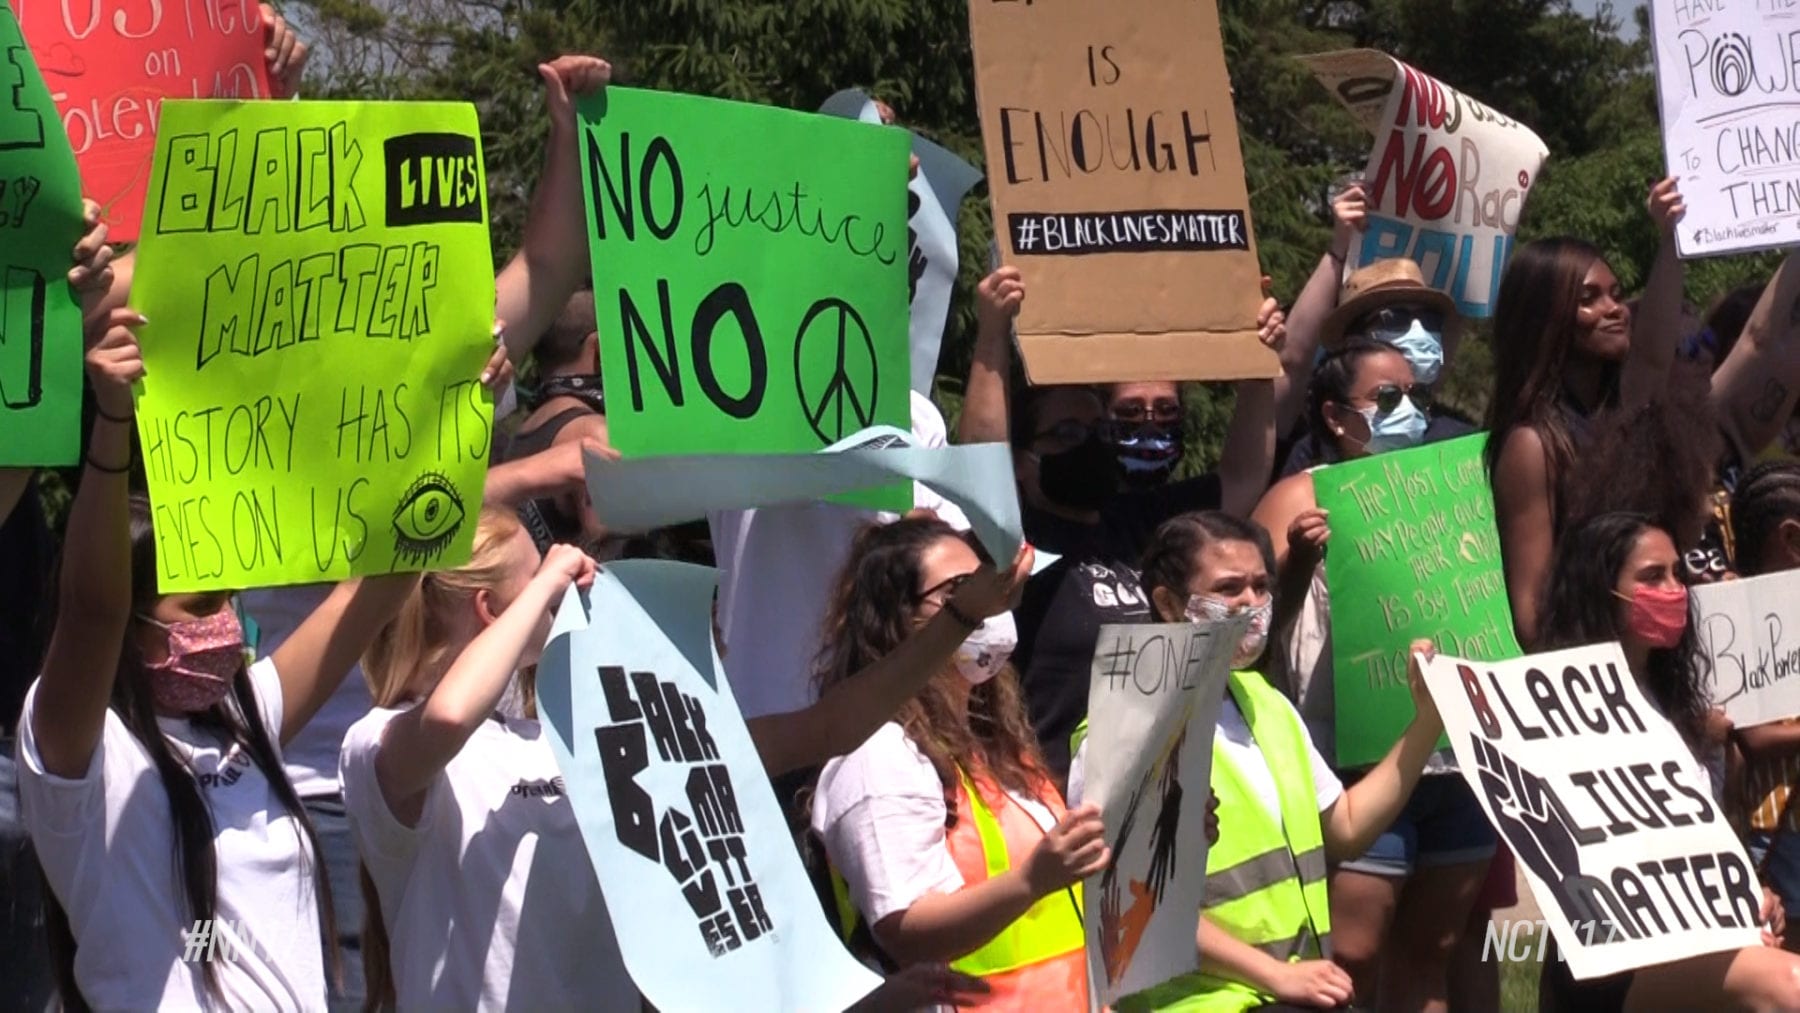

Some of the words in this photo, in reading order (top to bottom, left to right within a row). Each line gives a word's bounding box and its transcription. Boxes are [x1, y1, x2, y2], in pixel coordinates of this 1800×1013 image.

[145, 47, 181, 76] on
[1087, 45, 1121, 87] IS
[157, 121, 367, 235] BLACK
[400, 155, 478, 209] LIVES
[1000, 107, 1217, 184] ENOUGH
[1372, 130, 1457, 221] NO
[585, 127, 684, 242] NO
[695, 172, 896, 266] justice
[1017, 213, 1245, 250] #BLACKLIVESMATTER
[196, 242, 440, 371] MATTER
[618, 278, 768, 420] NO
[145, 393, 301, 485] HISTORY
[338, 383, 412, 463] HAS
[437, 378, 490, 464] ITS
[157, 494, 224, 581] EYES
[232, 489, 282, 571] ON
[311, 478, 370, 573] US
[1456, 661, 1648, 741] BLACK
